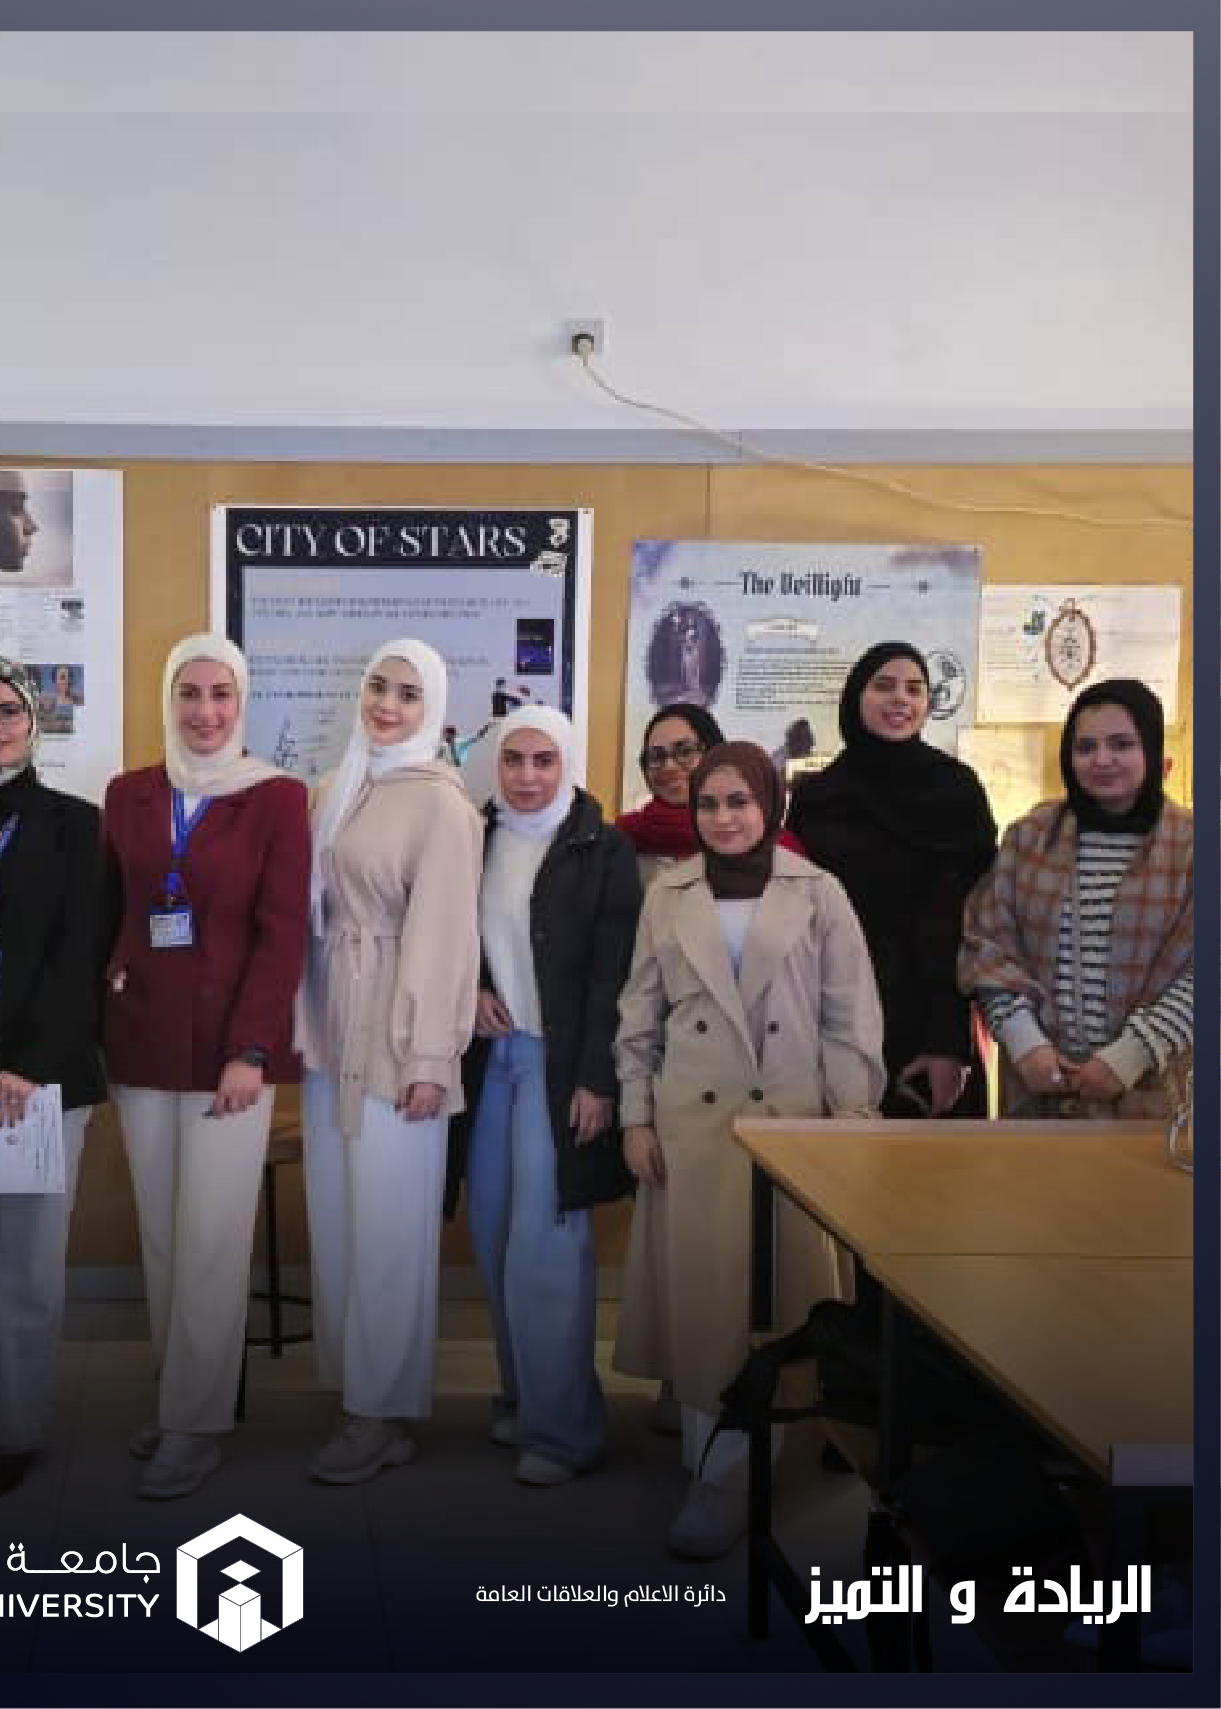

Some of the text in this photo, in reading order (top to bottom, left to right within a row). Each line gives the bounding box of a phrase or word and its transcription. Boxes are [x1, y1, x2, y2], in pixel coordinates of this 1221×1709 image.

[235, 523, 527, 557] CITY OF STARS
[741, 571, 774, 597] The
